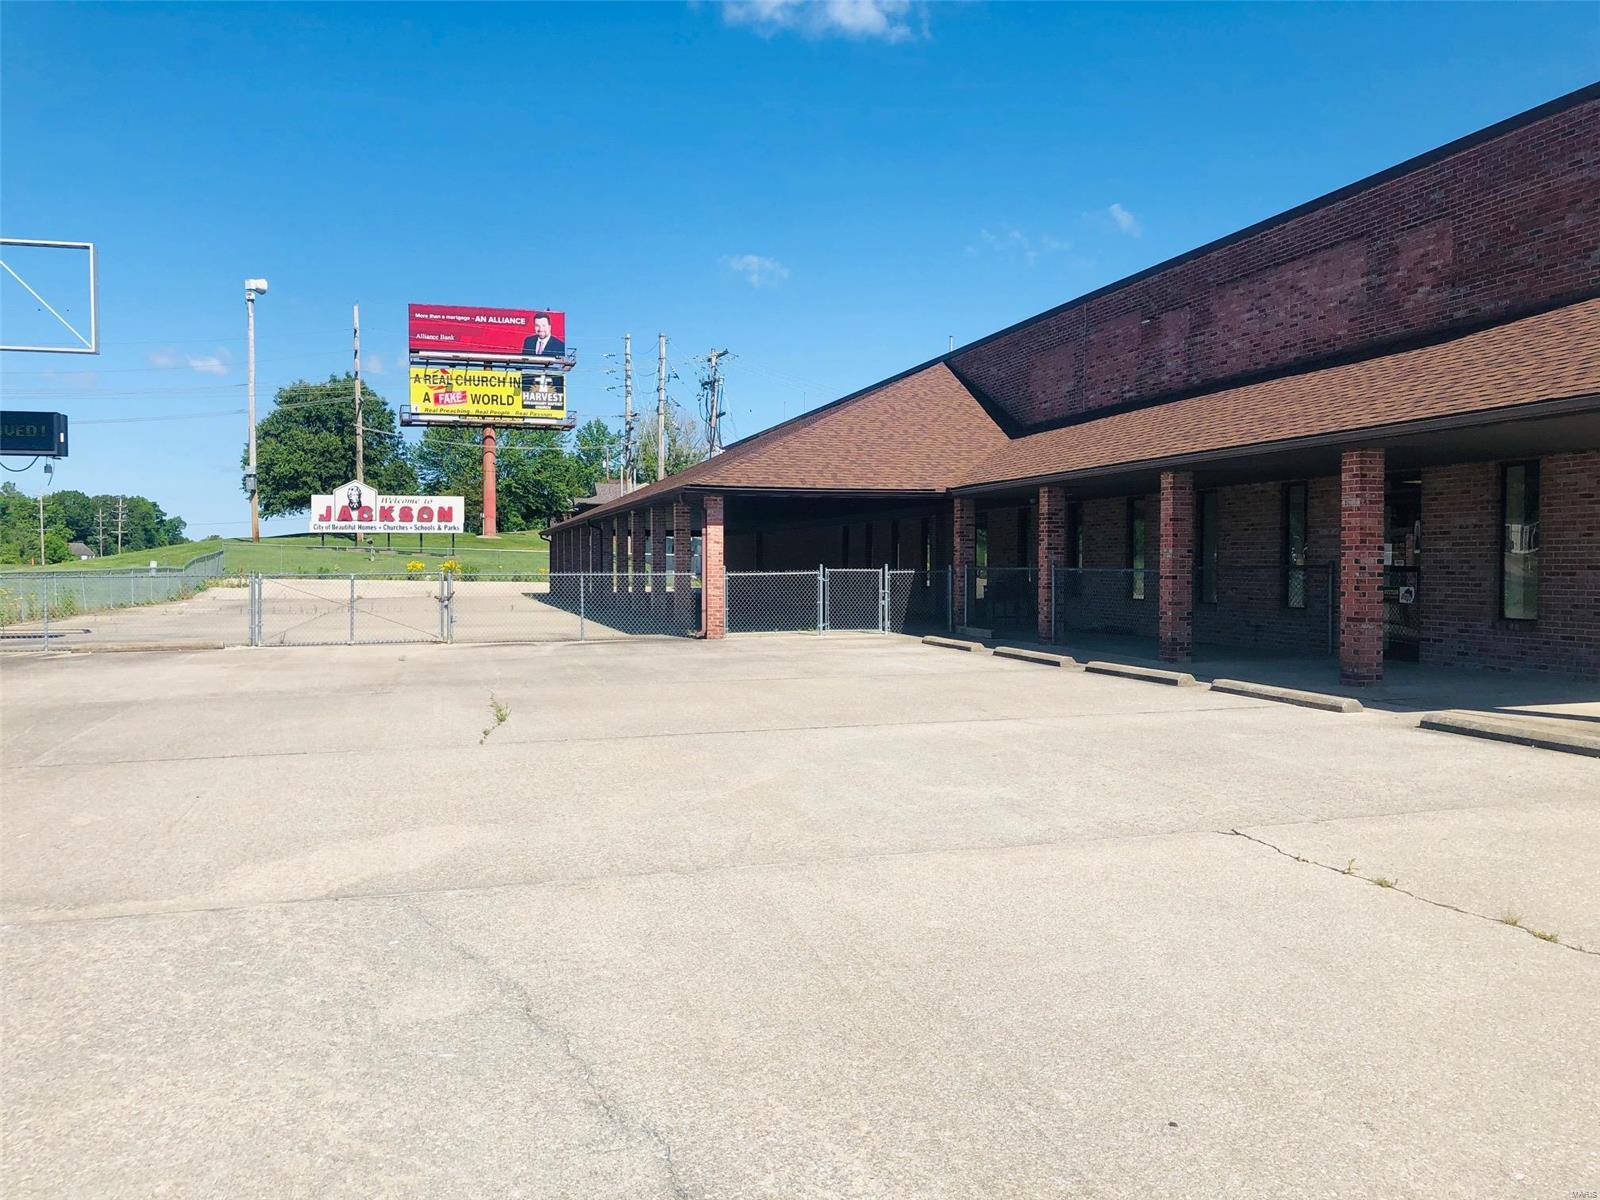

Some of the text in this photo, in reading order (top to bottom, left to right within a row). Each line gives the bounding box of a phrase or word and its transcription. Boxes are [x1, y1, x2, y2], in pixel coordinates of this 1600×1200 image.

[488, 316, 526, 325] ALLIANCE
[413, 374, 520, 389] A REAL CHURCH IN
[422, 392, 431, 403] A
[438, 392, 462, 404] FAKE
[470, 393, 515, 406] WORLD
[522, 391, 563, 402] HARVEST
[440, 407, 470, 415] Preaching
[318, 505, 453, 522] JACKSON
